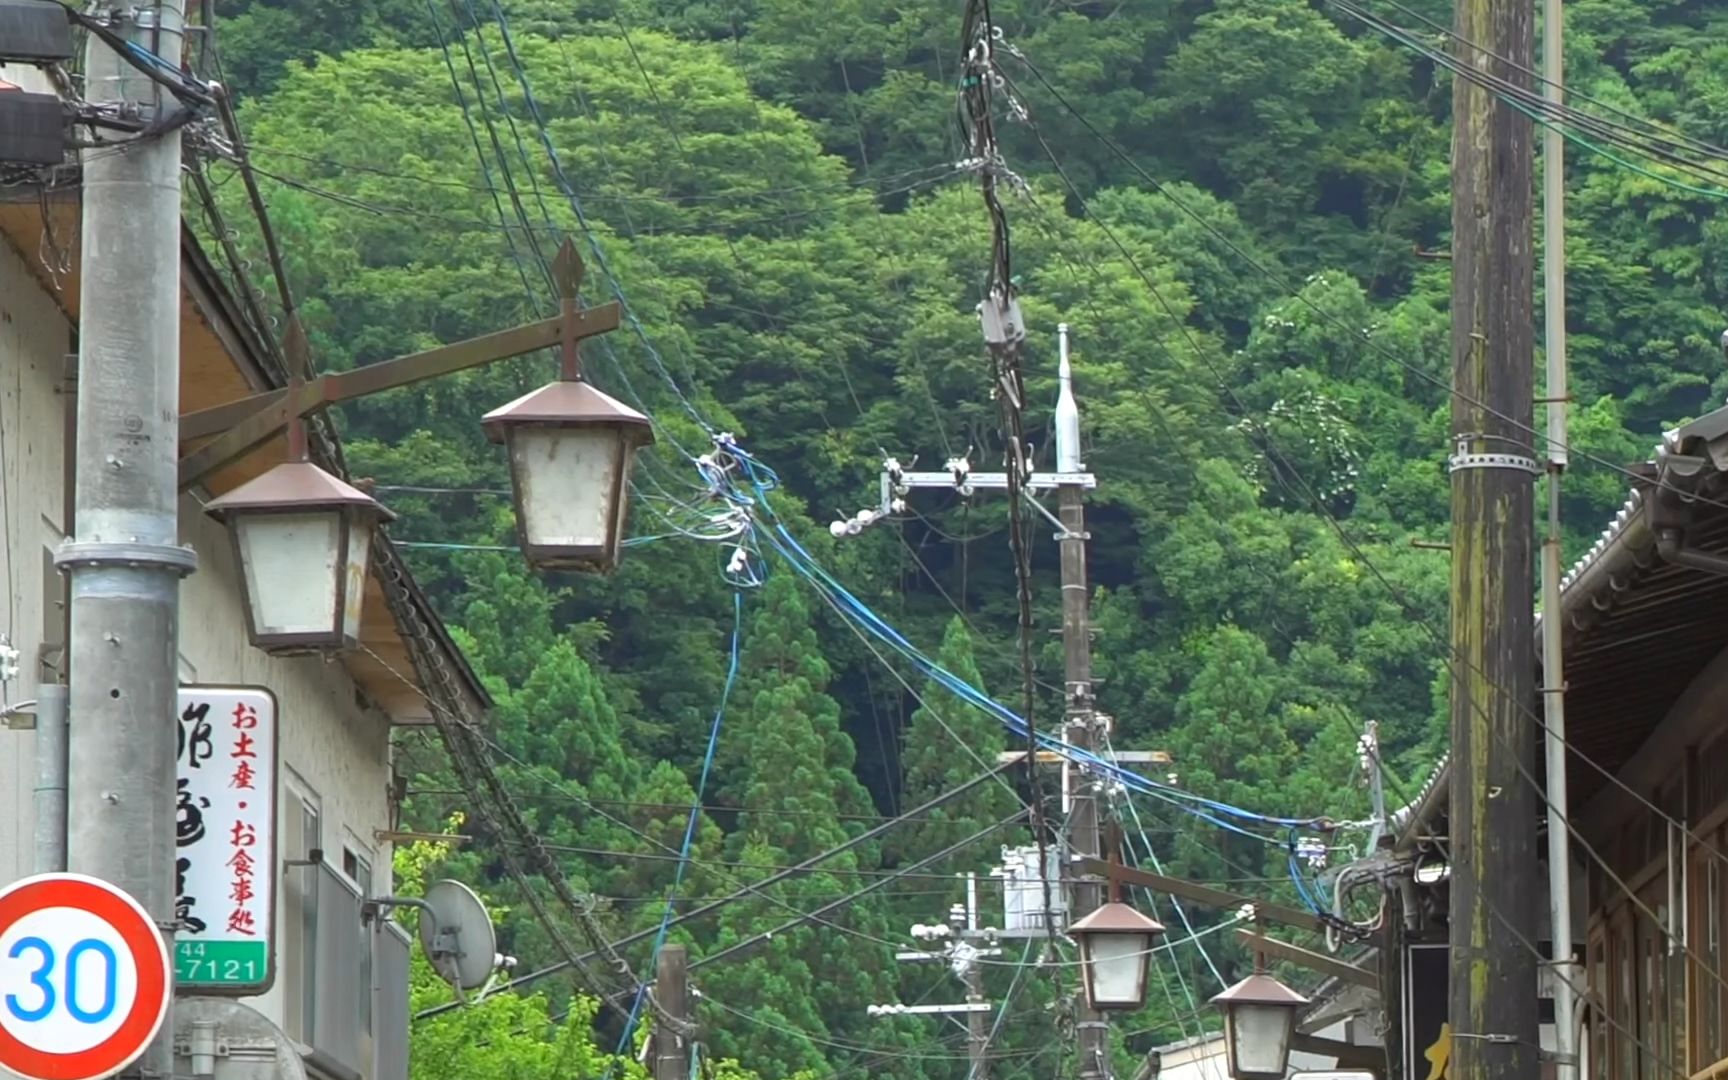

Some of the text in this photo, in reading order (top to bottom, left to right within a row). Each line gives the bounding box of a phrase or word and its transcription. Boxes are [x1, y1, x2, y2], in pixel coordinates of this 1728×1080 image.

[226, 702, 258, 936] お土産・お食事処
[5, 937, 118, 1024] 30
